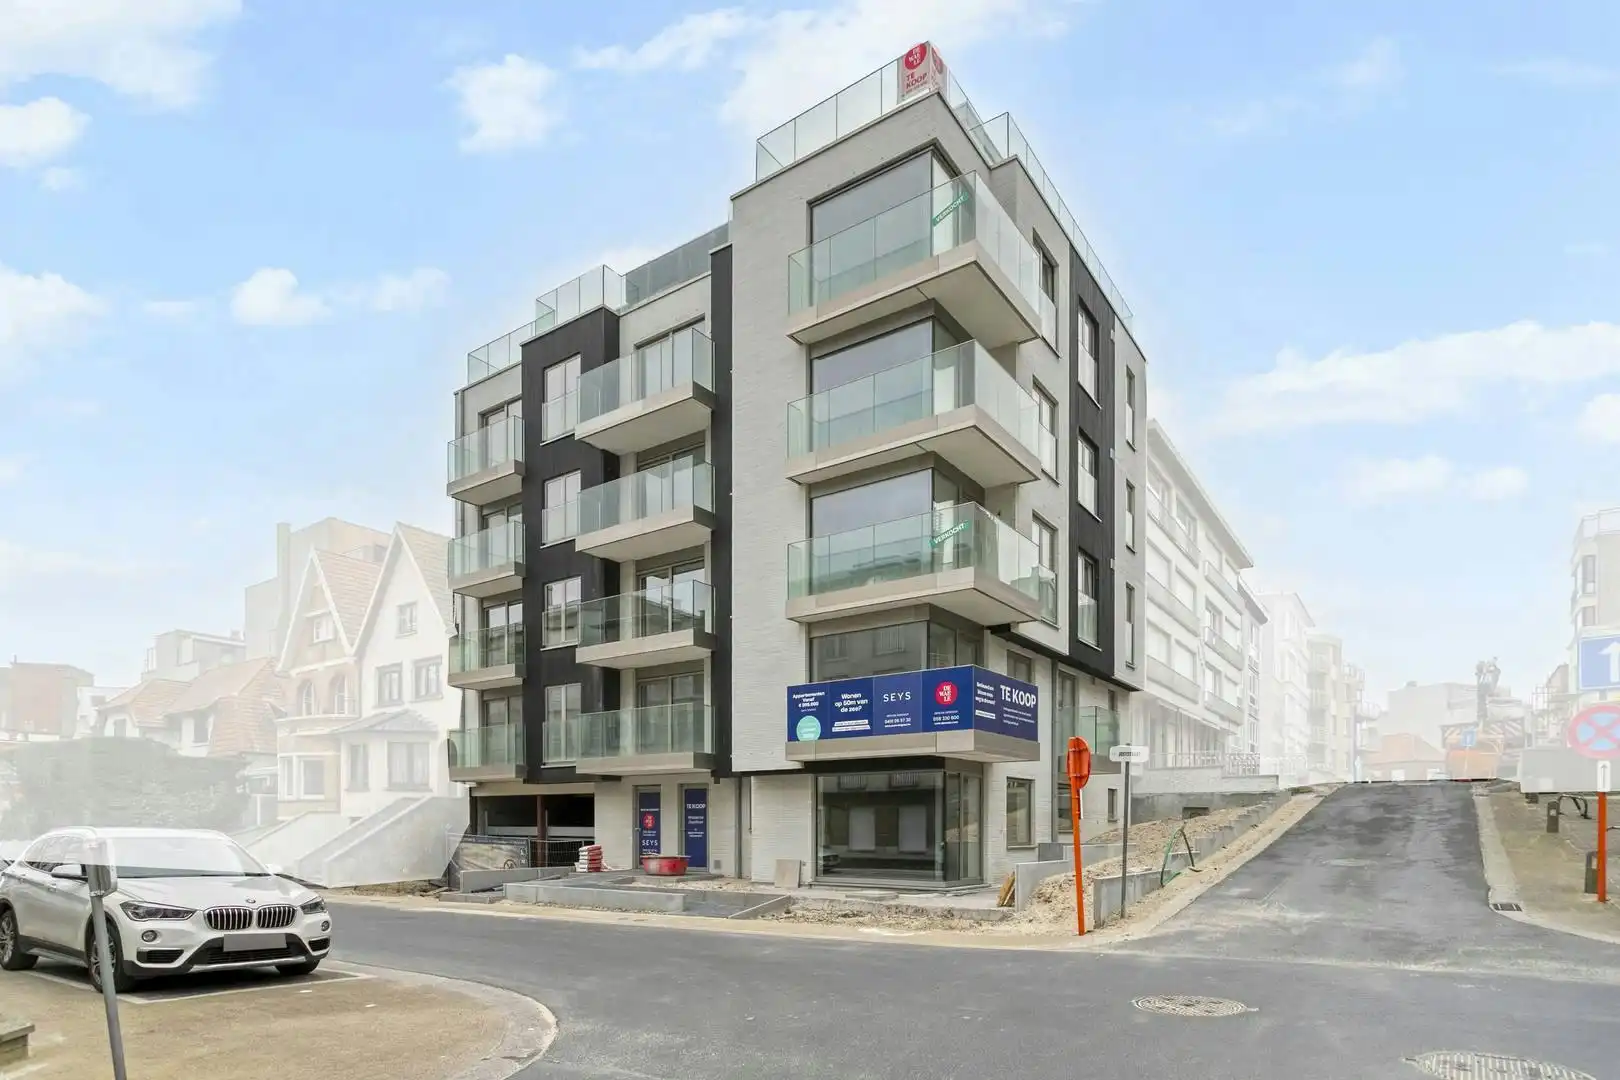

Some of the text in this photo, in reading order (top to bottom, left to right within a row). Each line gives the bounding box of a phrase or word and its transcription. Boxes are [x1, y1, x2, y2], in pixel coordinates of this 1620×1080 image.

[906, 72, 914, 81] TE
[906, 72, 928, 88] KOOP
[935, 195, 965, 222] VERKOCHT
[934, 522, 966, 544] VERKOCHT
[883, 692, 911, 702] SEYS
[1000, 685, 1011, 702] TE
[1012, 688, 1036, 708] KOOP
